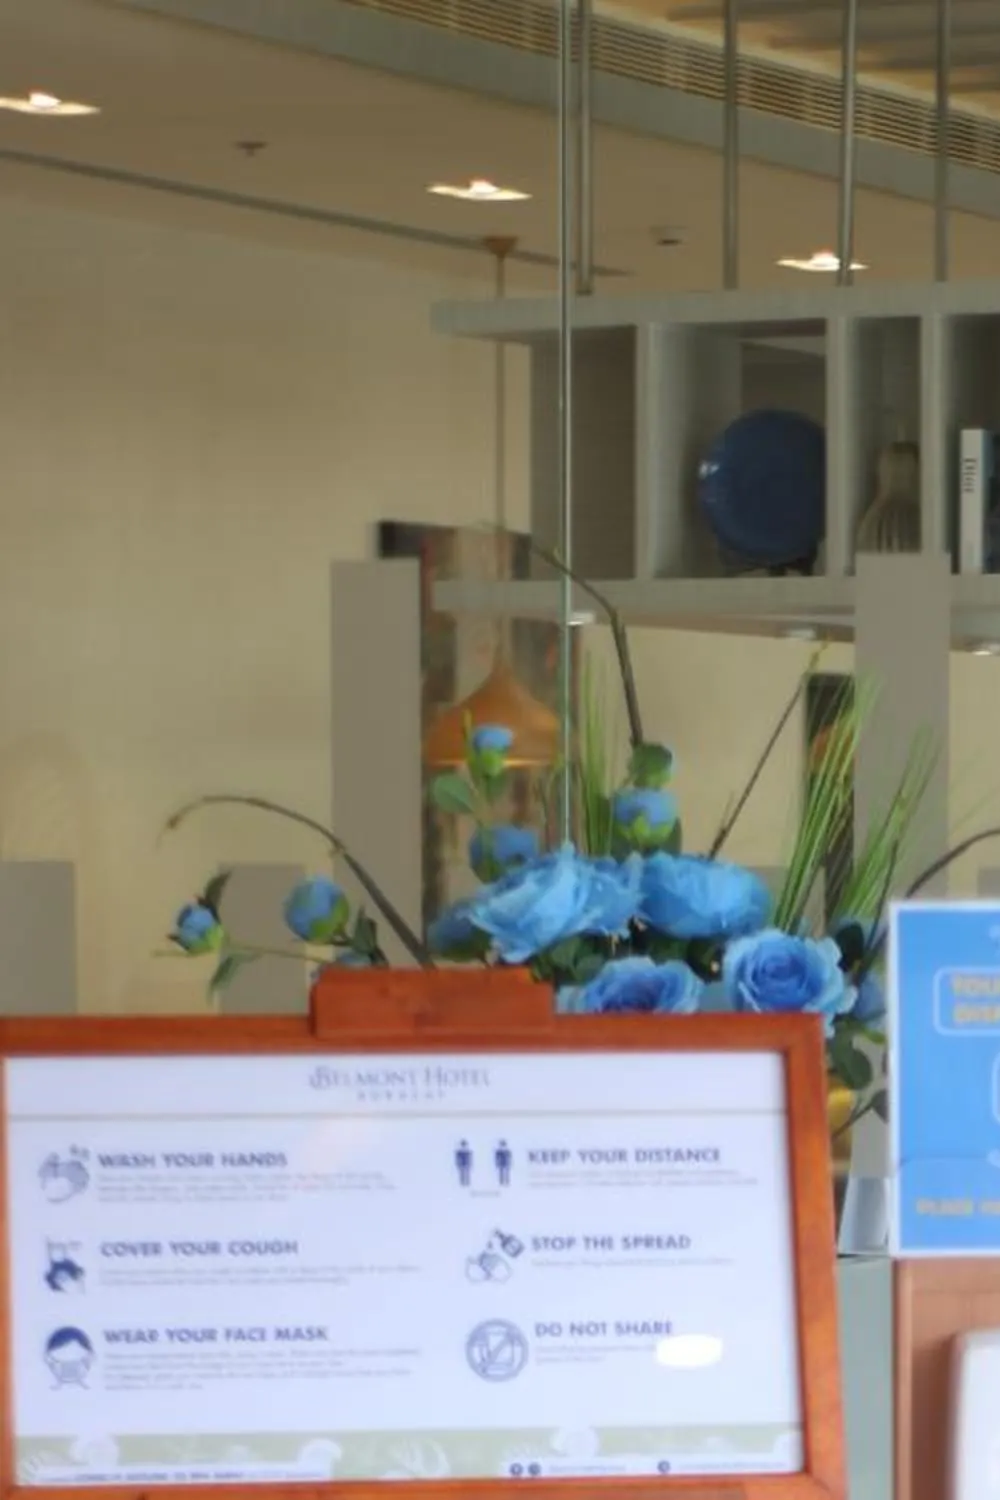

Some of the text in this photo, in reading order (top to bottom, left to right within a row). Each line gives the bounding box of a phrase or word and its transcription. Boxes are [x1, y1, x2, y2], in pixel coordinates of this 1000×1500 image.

[98, 1152, 288, 1168] WASH YOUR HANDS
[528, 1148, 720, 1164] KEEP YOUR DISTANCE
[101, 1240, 298, 1256] COVER YOUR COUGH
[531, 1235, 691, 1252] STOP THE SPREAD
[104, 1327, 328, 1344] WEAR YOUR FACE MASK
[535, 1321, 673, 1337] DO NOT SHARE
